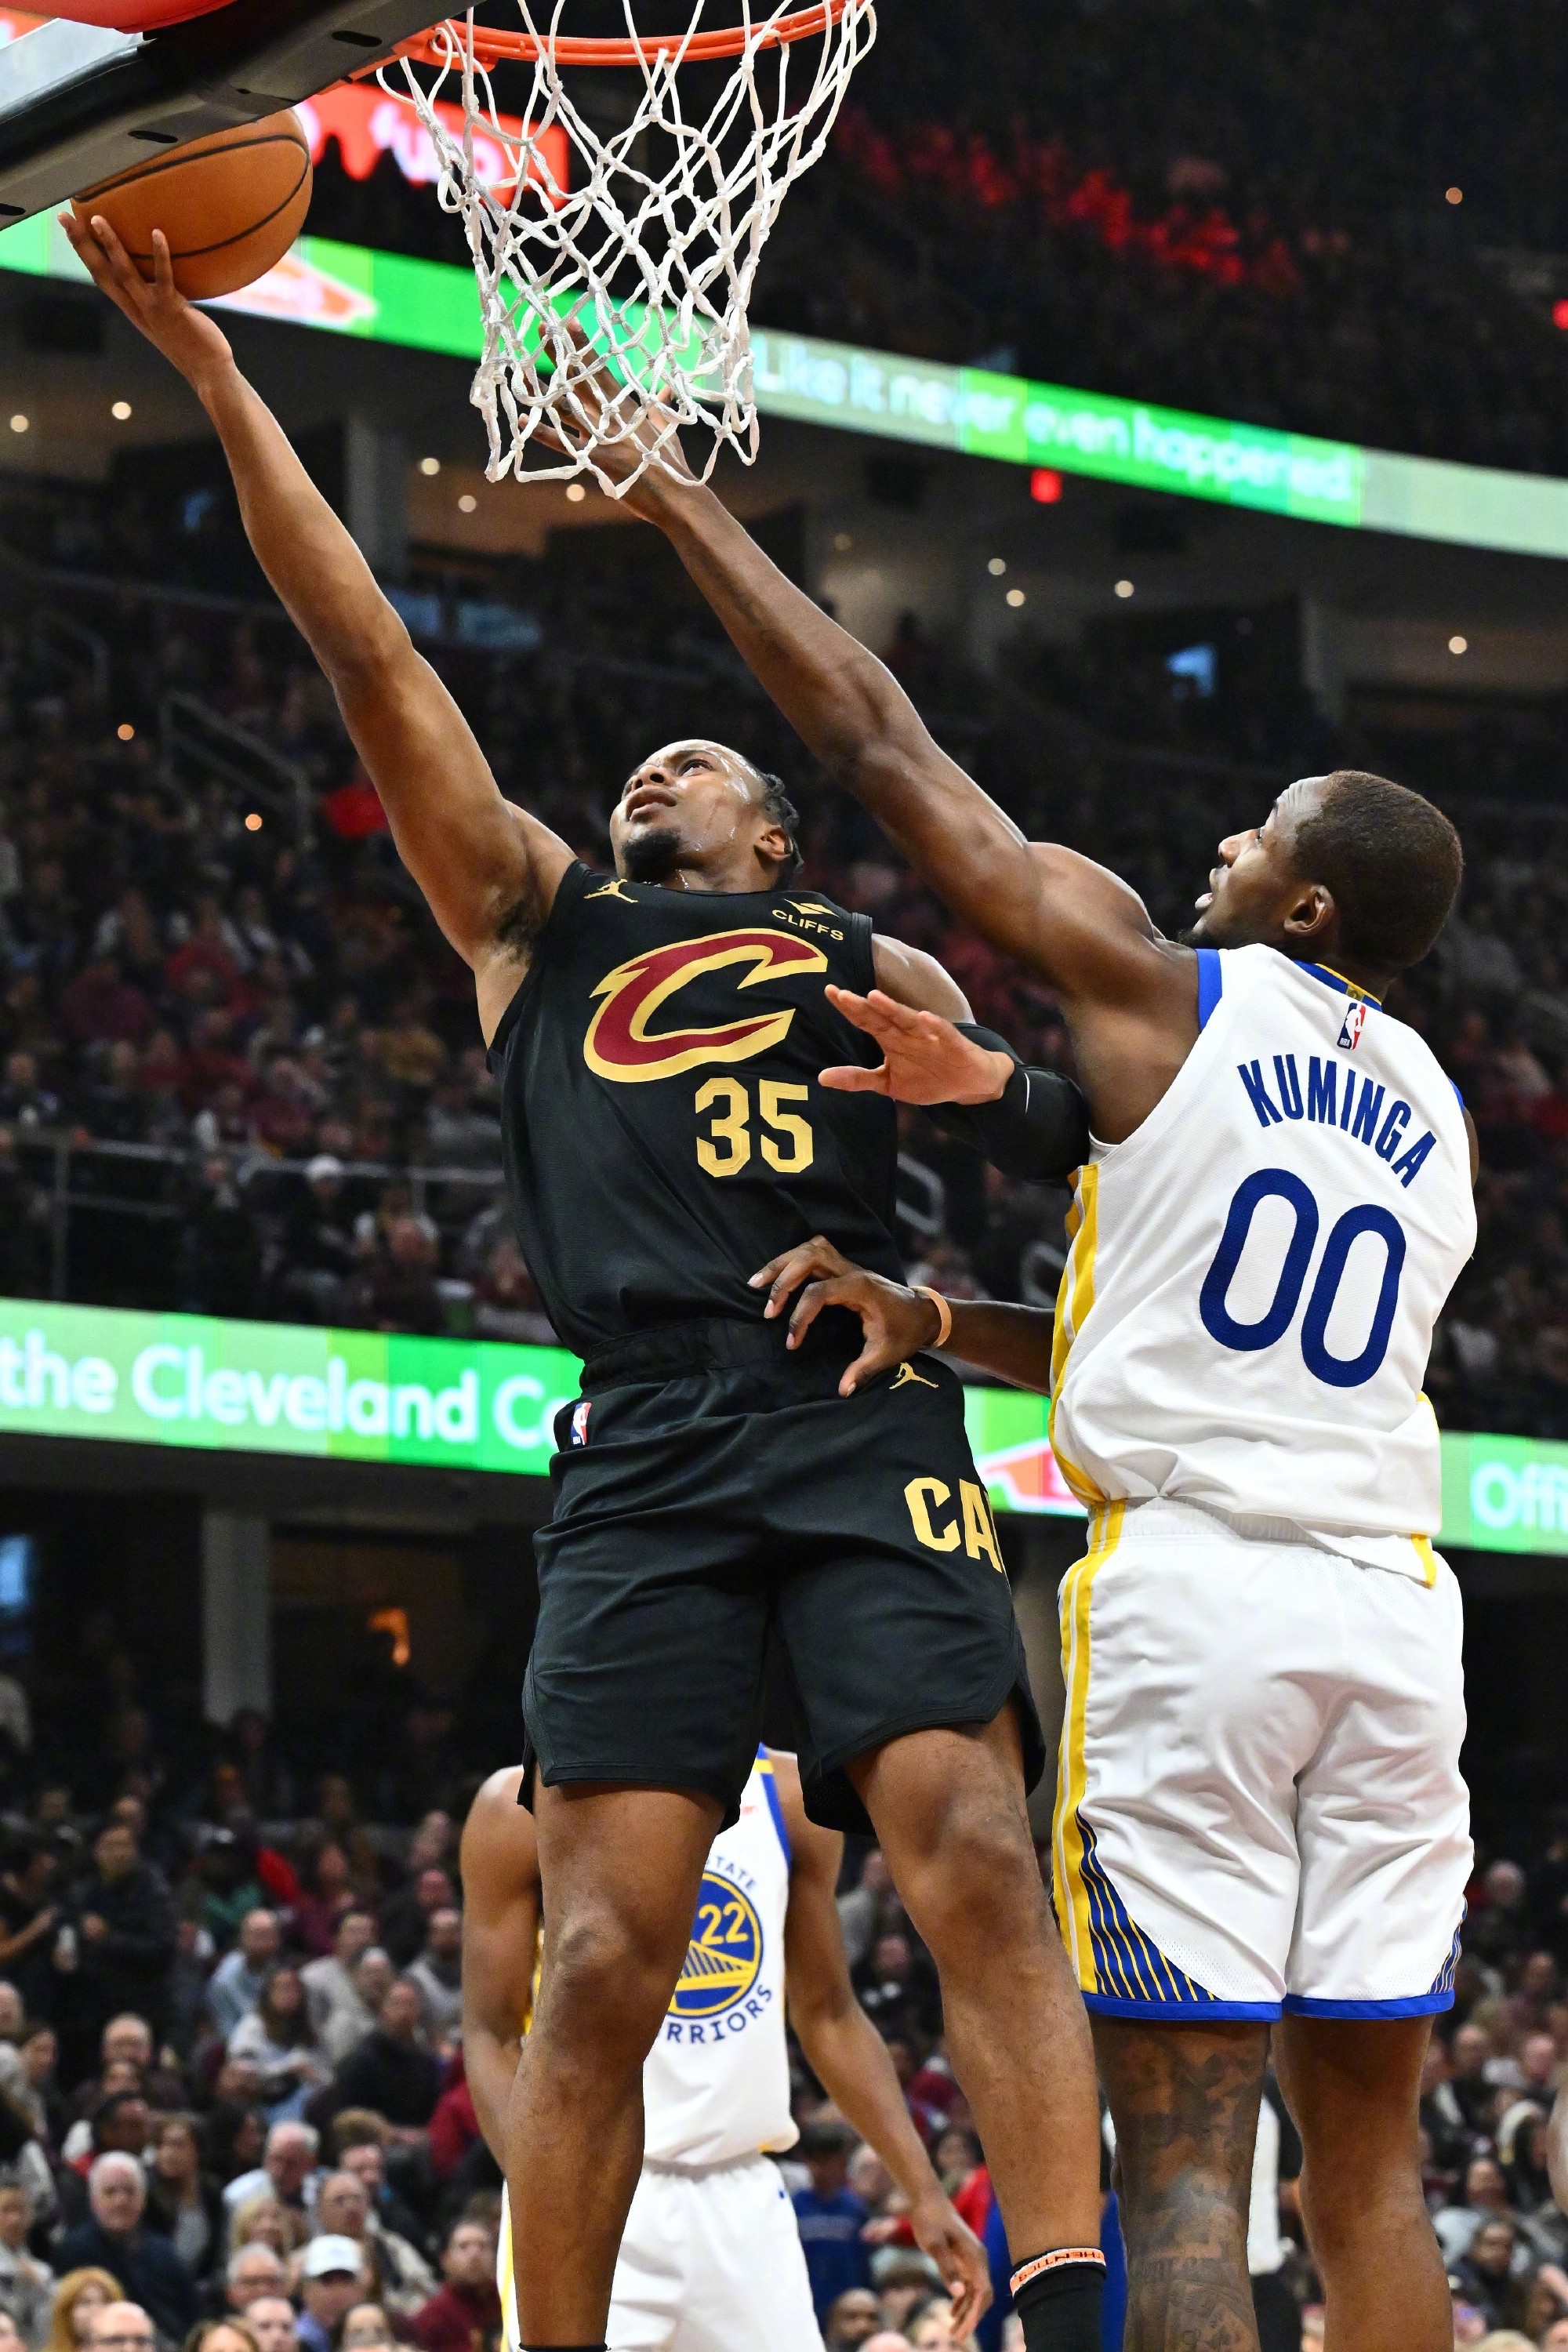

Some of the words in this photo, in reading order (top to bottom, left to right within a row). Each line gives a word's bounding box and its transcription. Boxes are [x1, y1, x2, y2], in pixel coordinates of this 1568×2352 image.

[771, 909, 844, 941] CLIFFS
[695, 1077, 814, 1178] 35
[1236, 1054, 1437, 1189] KUMINGA
[1200, 1168, 1406, 1387] 00
[0, 1328, 118, 1414] the
[132, 1344, 481, 1442] Cleveland
[904, 1477, 1005, 1577] CA
[699, 1901, 749, 1945] 22
[706, 1855, 757, 1892] TATE
[658, 1984, 773, 2044] RRIORS
